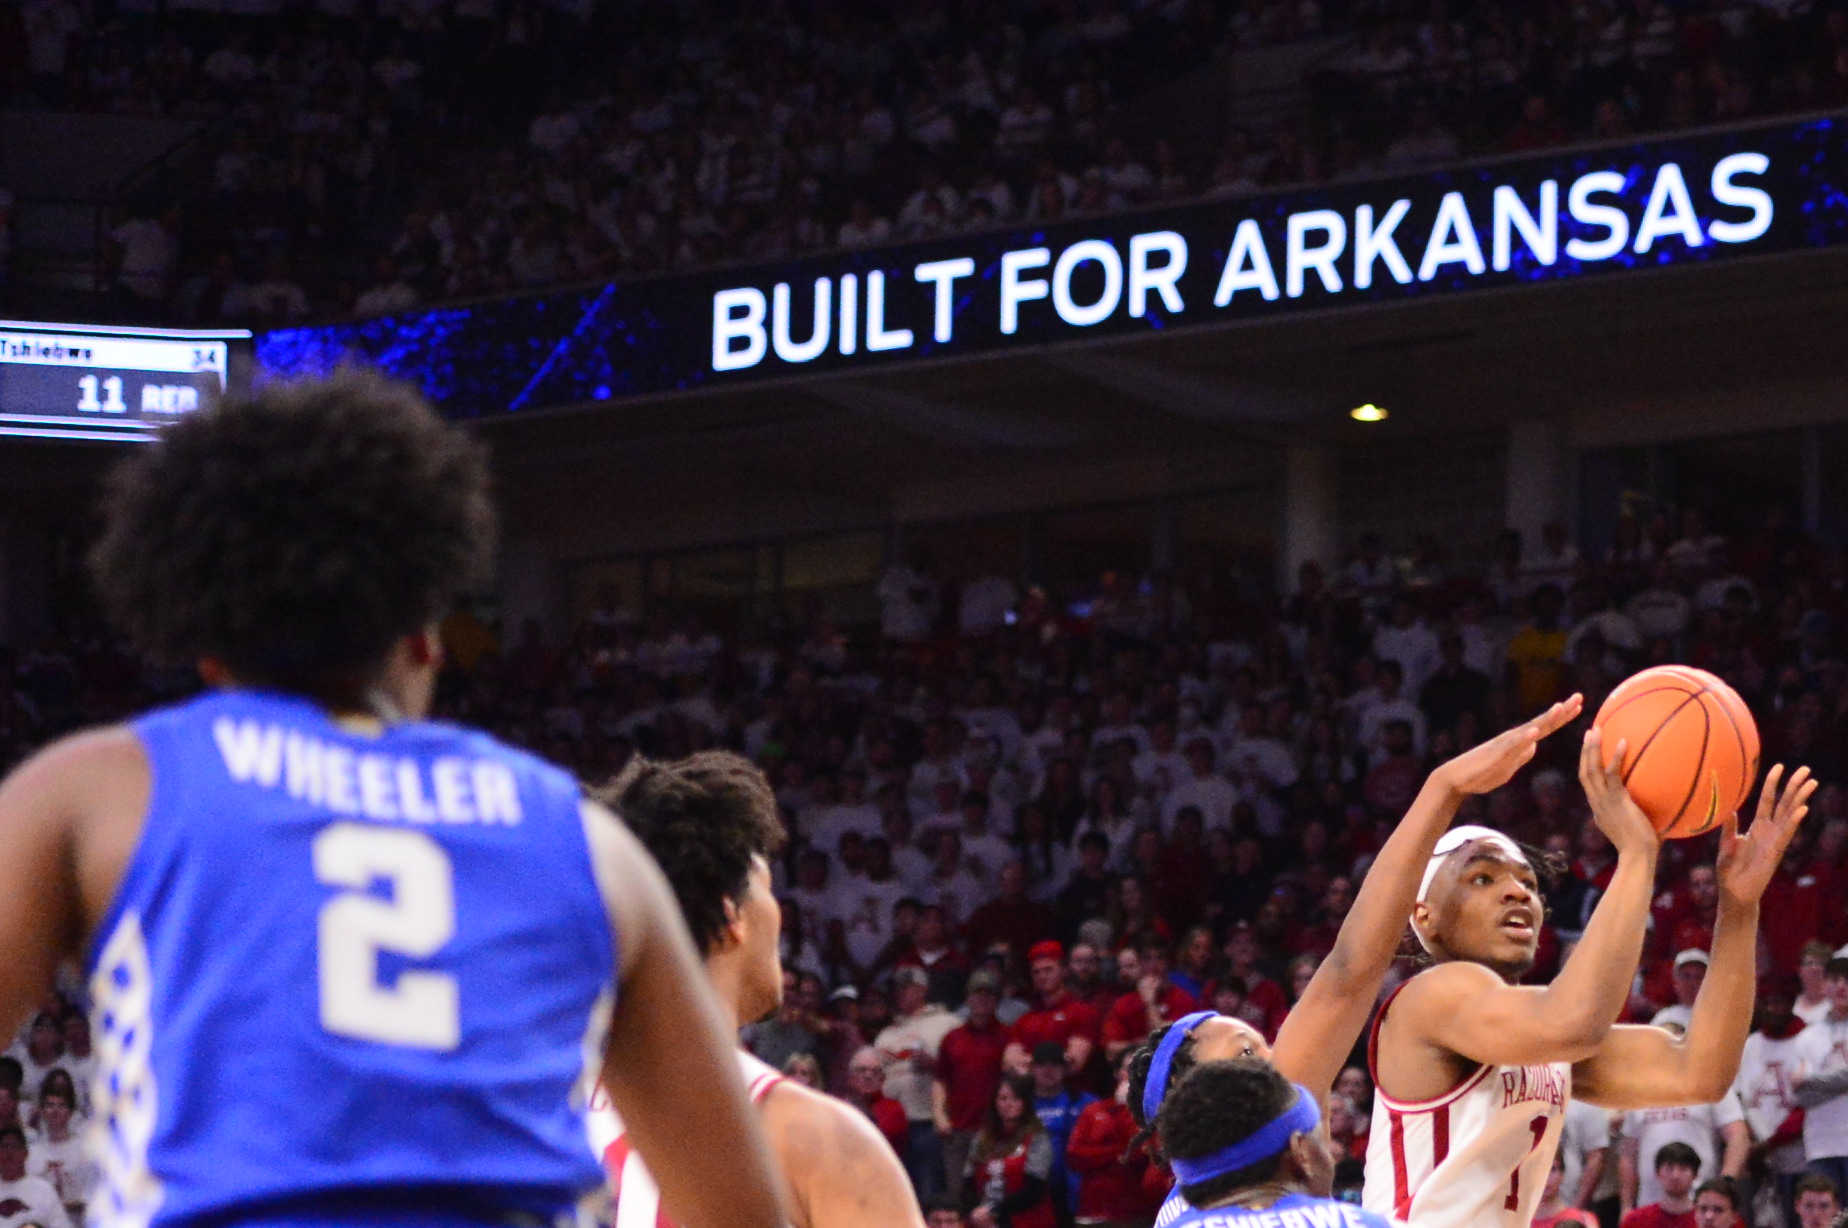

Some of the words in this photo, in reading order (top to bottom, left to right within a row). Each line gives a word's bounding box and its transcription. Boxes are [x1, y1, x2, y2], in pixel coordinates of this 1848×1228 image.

[713, 257, 975, 372] BUILT
[1000, 231, 1188, 335] FOR
[1214, 152, 1774, 308] ARKANSAS
[77, 374, 127, 414] 11
[213, 715, 523, 825] WHEELER
[312, 821, 460, 1051] 2
[1504, 1115, 1548, 1212] 1
